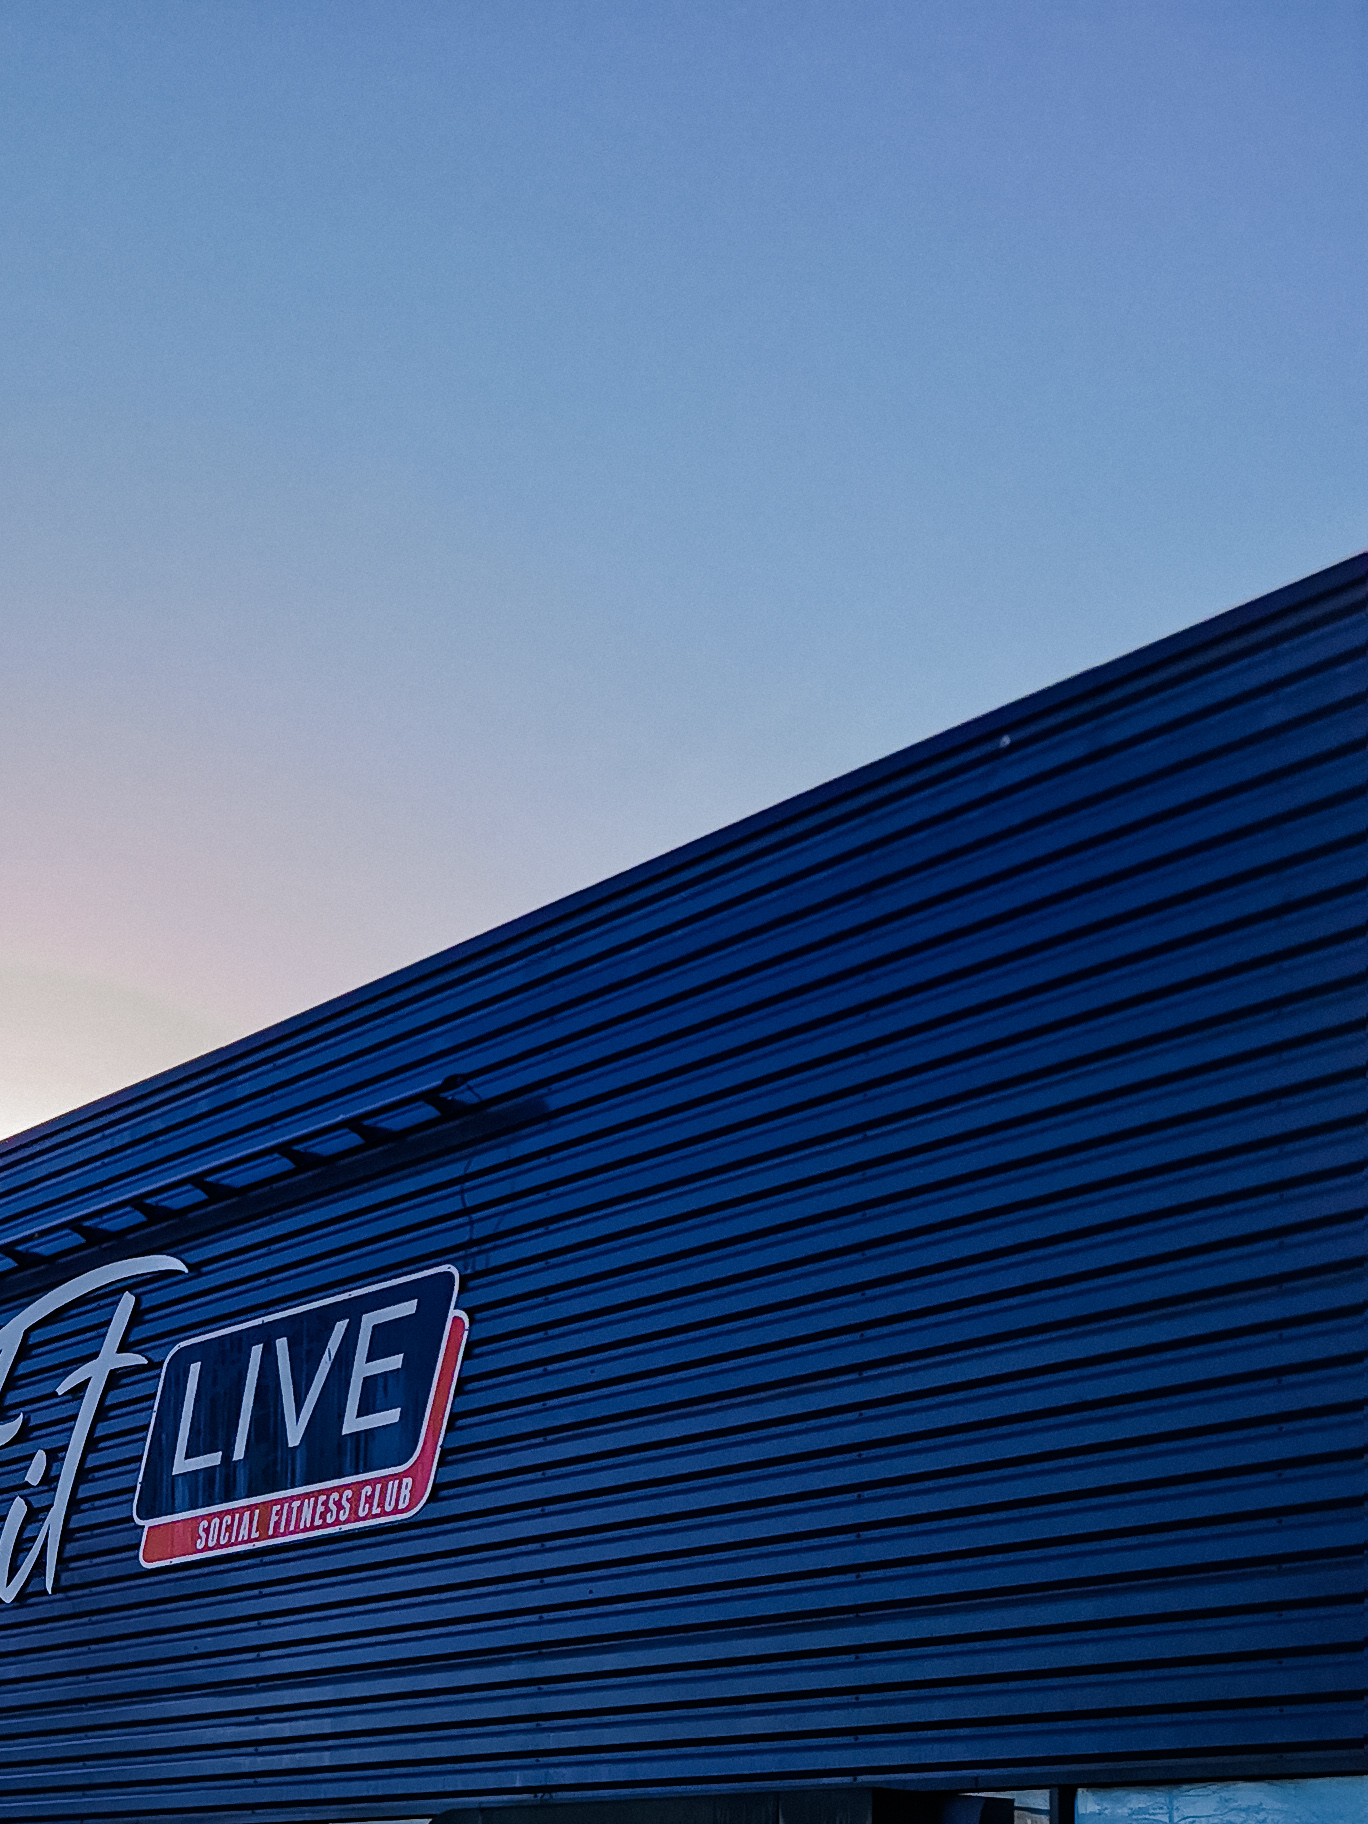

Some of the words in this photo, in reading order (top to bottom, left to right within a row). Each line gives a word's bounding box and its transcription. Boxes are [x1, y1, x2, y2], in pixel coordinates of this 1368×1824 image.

[172, 1298, 419, 1476] LIVE
[195, 1509, 261, 1550] SOCIAL
[267, 1489, 353, 1536] FITNESS
[357, 1476, 414, 1518] CLUB
